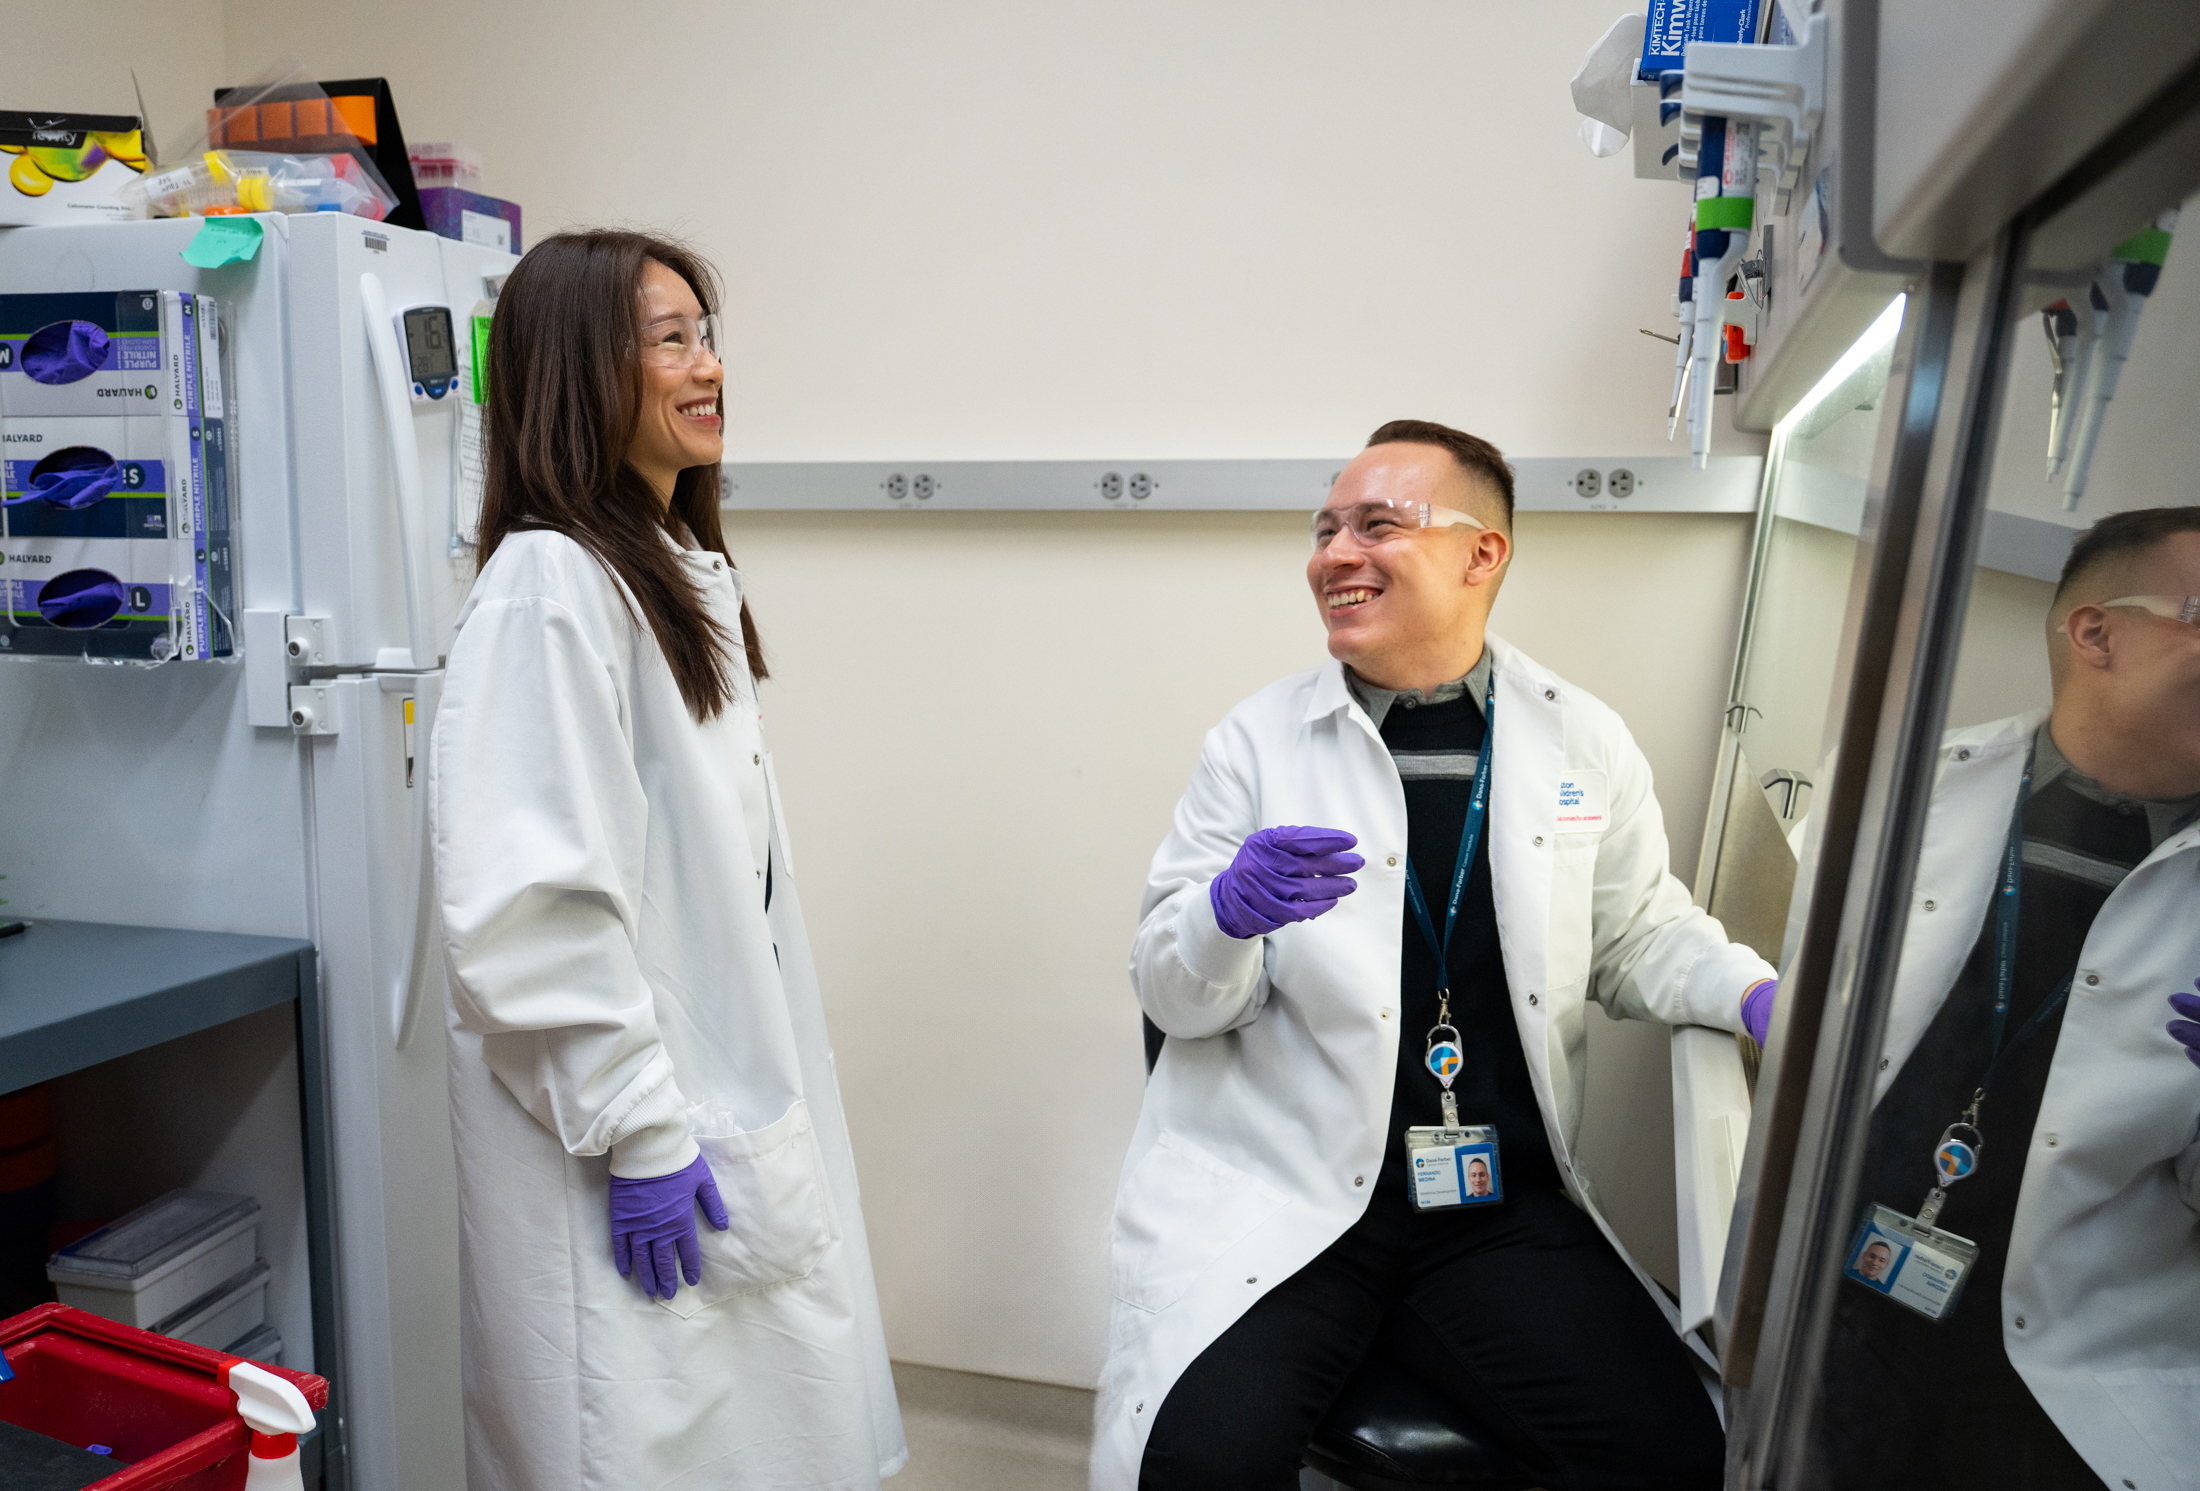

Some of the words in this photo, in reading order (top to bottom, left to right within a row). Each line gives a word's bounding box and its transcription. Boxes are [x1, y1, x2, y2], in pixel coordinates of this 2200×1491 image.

[1651, 3, 1665, 55] KIMTECH
[1660, 0, 1686, 56] Kimw
[184, 304, 191, 314] M
[123, 351, 156, 359] NITRILE
[124, 359, 157, 368] PURPLE
[184, 334, 192, 371] NITRILE
[173, 354, 181, 396] HALYARD
[185, 373, 194, 409] PURPLE
[129, 468, 139, 484] S
[192, 458, 200, 494] NITRILE
[8, 555, 52, 564] HALYARD
[198, 552, 205, 560] L
[136, 591, 145, 607] L
[197, 617, 205, 652] PURPLE
[1475, 764, 1488, 799] Dana-Farber
[1452, 868, 1465, 905] Dana-Farber
[1462, 852, 1470, 867] Cancer
